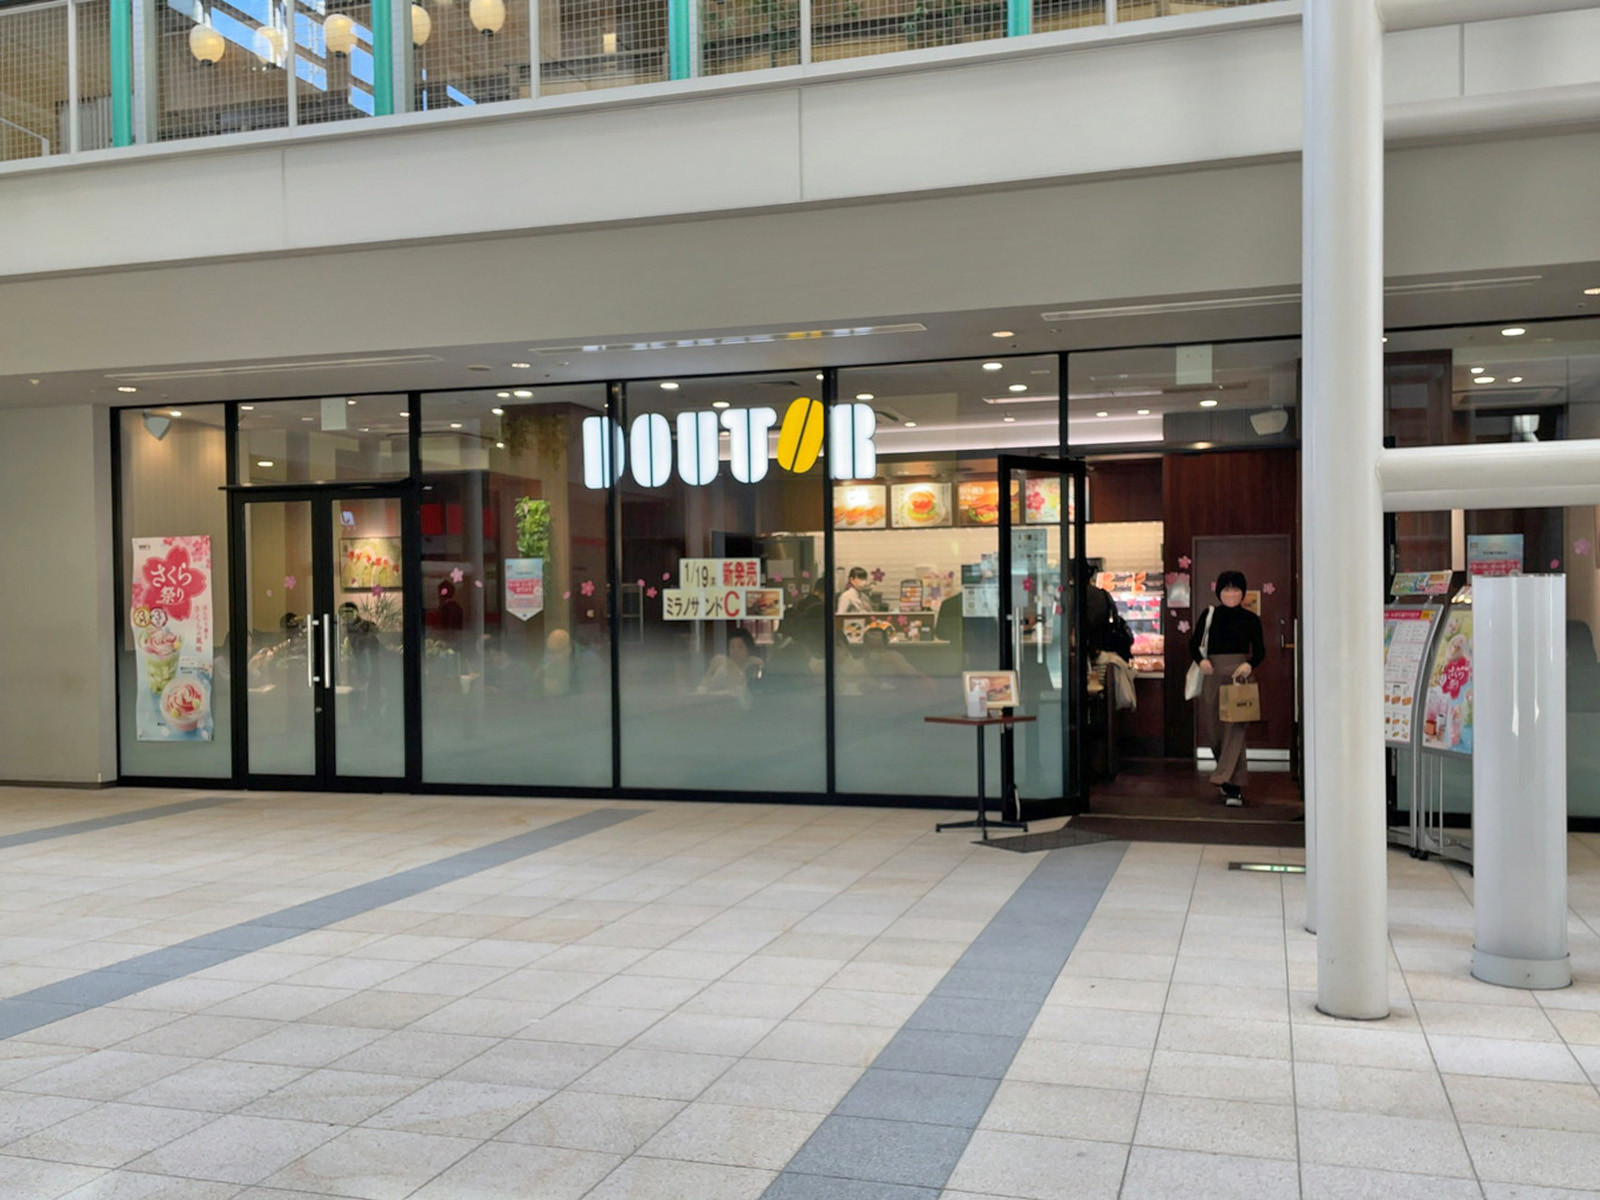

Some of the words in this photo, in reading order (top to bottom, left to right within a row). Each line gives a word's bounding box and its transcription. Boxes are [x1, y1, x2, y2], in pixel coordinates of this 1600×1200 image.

[582, 397, 876, 489] DOUTOR
[150, 561, 192, 588] さくら
[722, 561, 757, 587] 新発売
[156, 586, 185, 606] 祭り
